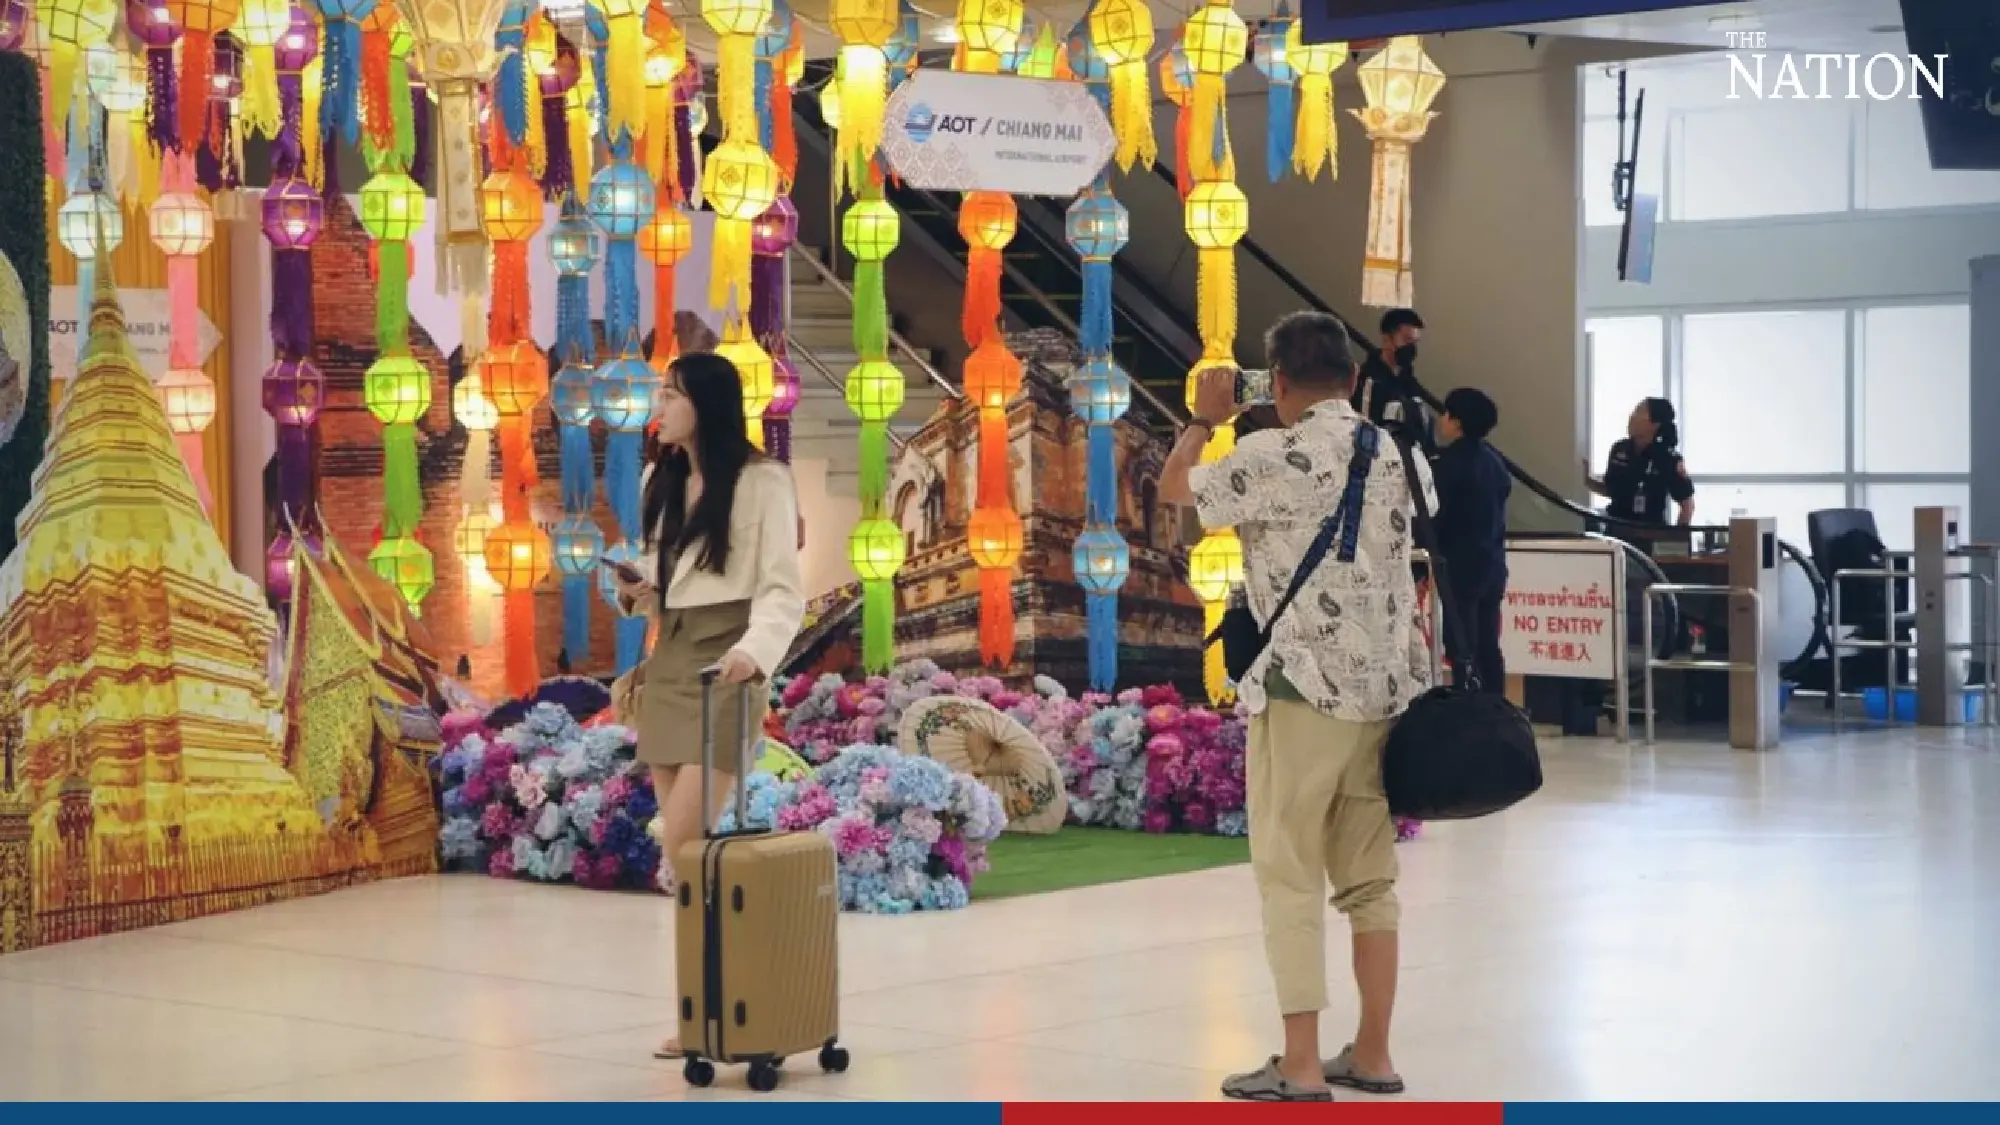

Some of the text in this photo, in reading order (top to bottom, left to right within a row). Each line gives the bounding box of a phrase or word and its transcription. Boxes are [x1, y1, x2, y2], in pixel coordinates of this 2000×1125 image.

[937, 115, 977, 134] AOT
[996, 119, 1051, 140] CHIANG
[1054, 123, 1083, 142] MAI
[1514, 615, 1604, 635] NO ENTRY
